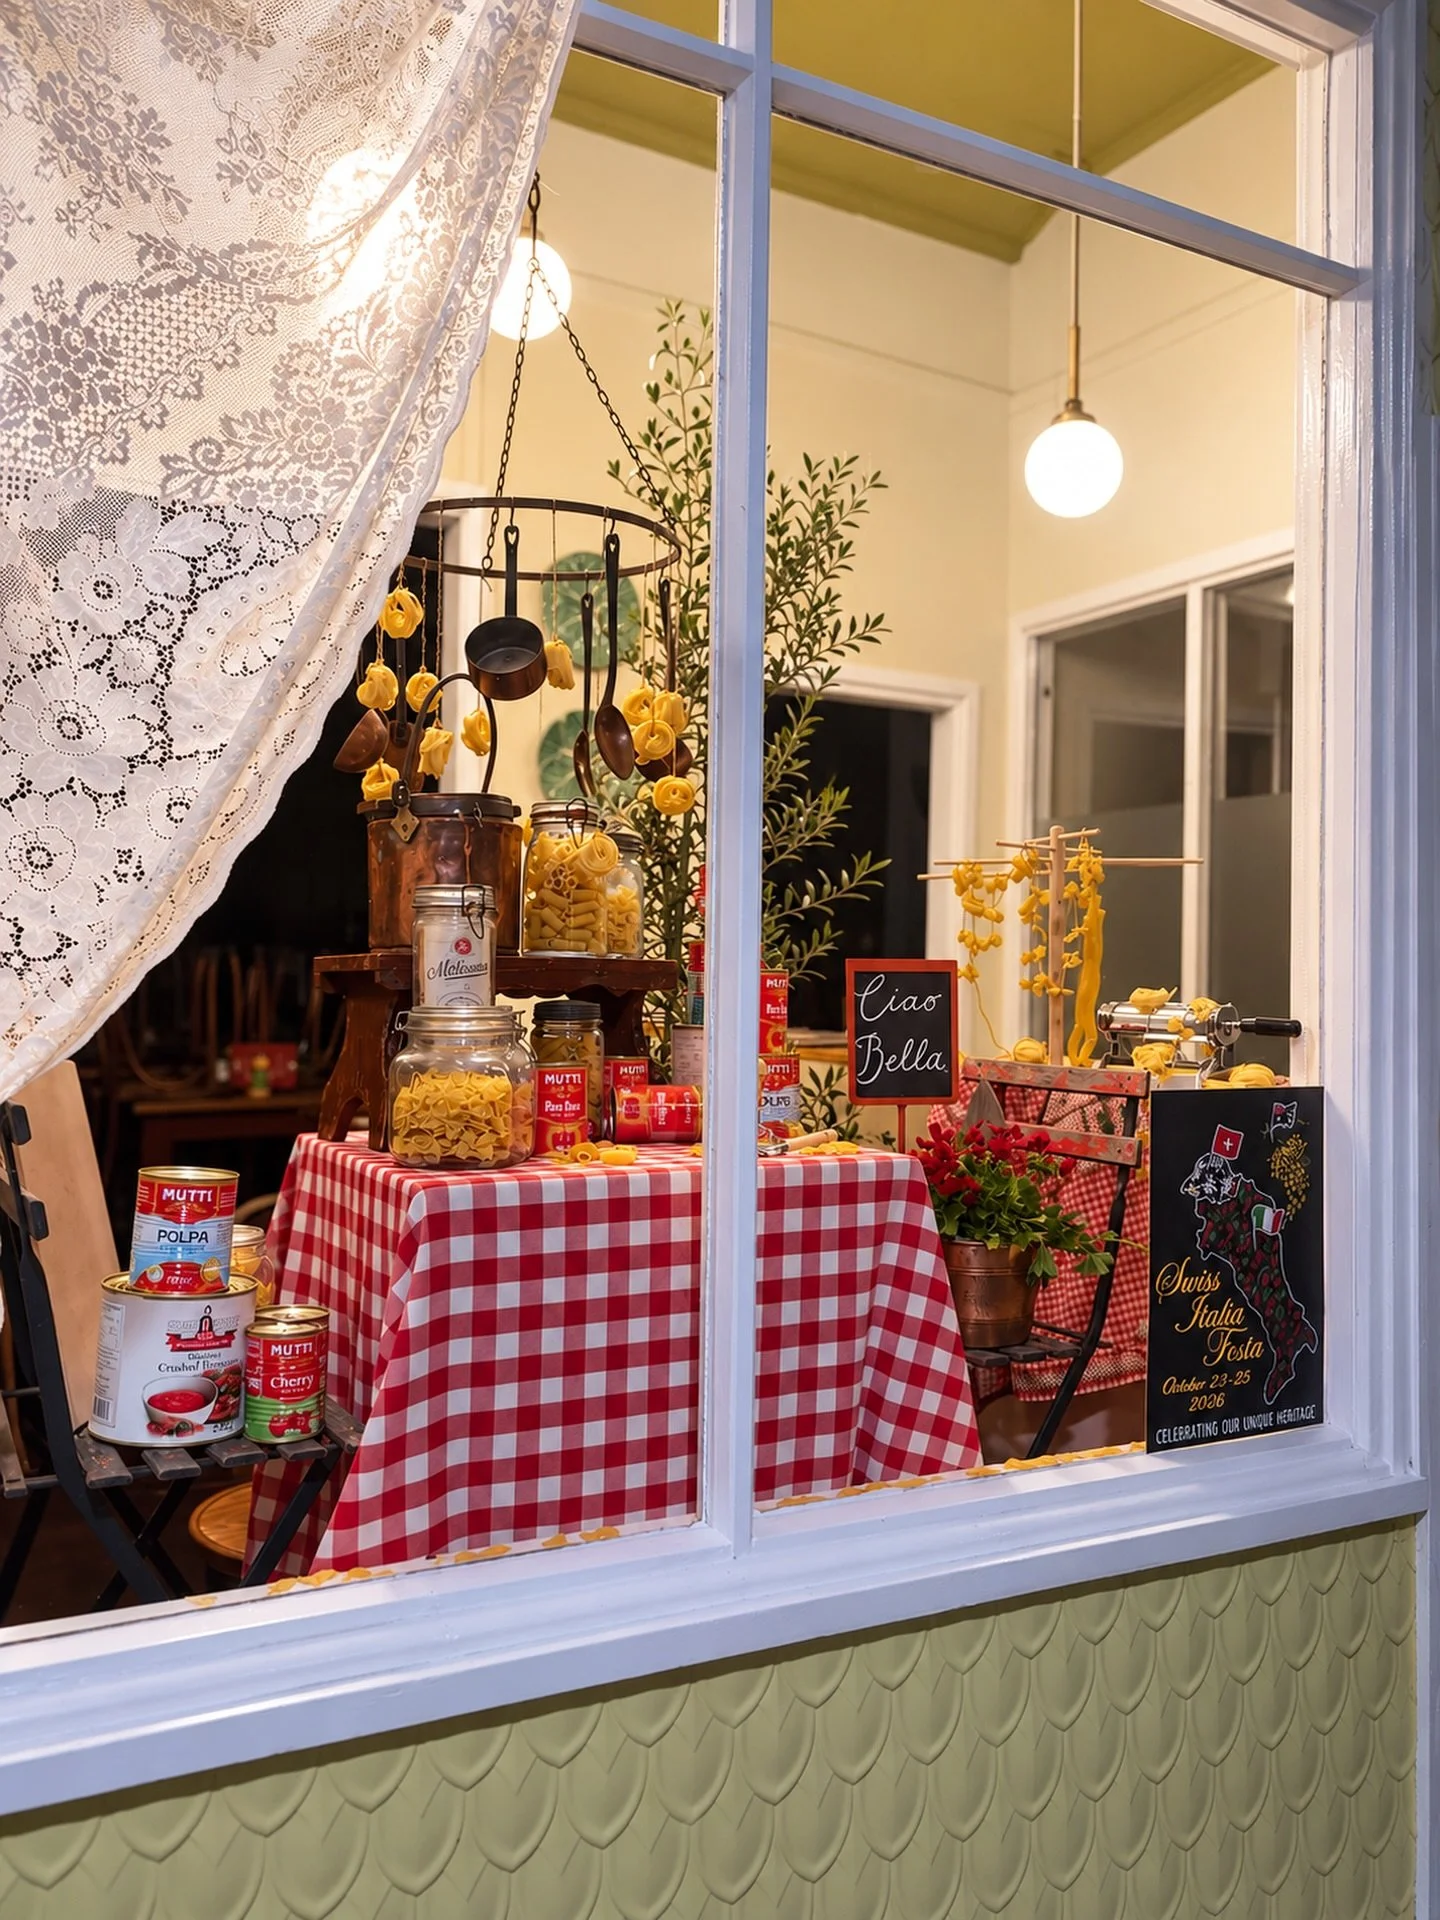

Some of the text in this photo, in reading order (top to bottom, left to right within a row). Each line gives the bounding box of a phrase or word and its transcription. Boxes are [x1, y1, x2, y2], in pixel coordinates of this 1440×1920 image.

[853, 973, 943, 1022] Ciao
[855, 1031, 947, 1085] Bella
[544, 1073, 582, 1085] MUTTI
[162, 1188, 213, 1202] MUTTI
[157, 1229, 209, 1244] POLPA
[1155, 1256, 1222, 1305] Swiss
[1174, 1293, 1245, 1333] Italia
[270, 1342, 313, 1356] MUTTI
[1202, 1326, 1264, 1367] Festa
[270, 1374, 314, 1390] Cherry
[1162, 1376, 1206, 1396] October
[1155, 1420, 1219, 1445] CELEBRATING
[1221, 1416, 1240, 1433] OUR
